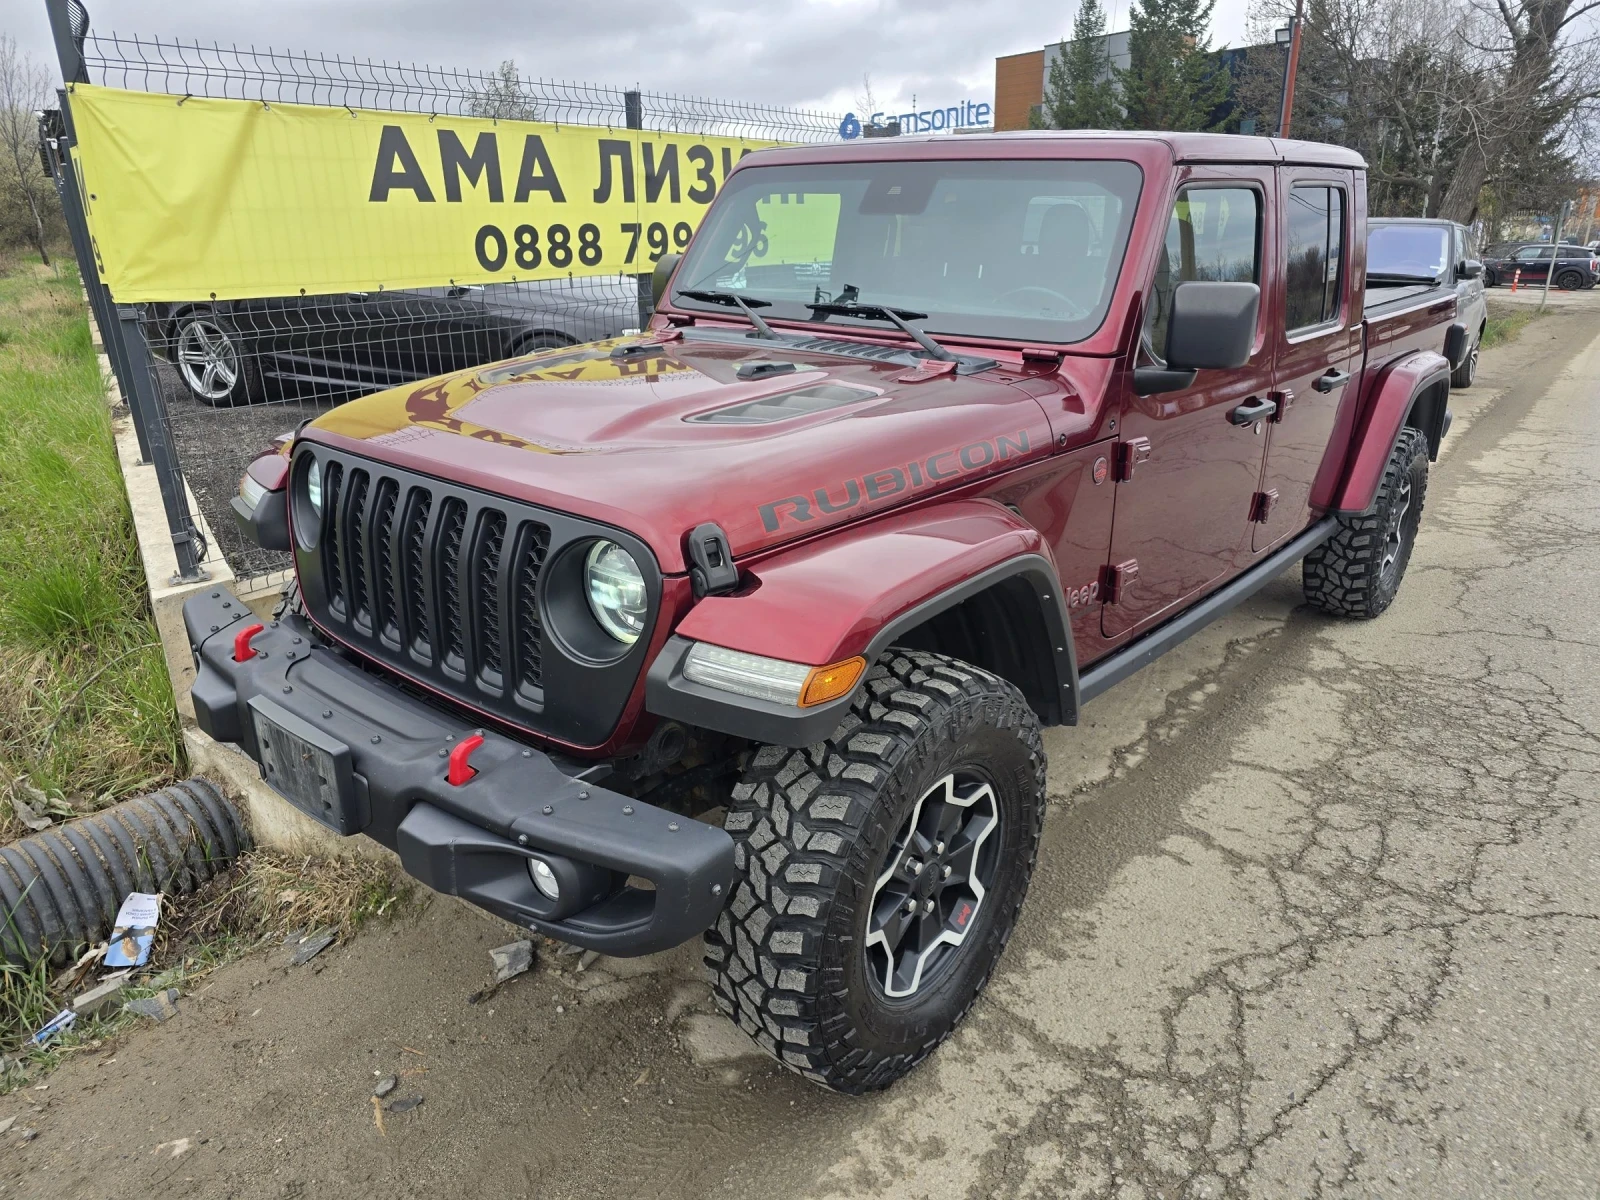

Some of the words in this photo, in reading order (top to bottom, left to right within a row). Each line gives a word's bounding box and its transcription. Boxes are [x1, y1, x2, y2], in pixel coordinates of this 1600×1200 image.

[368, 125, 566, 203] АМА
[474, 223, 603, 272] 0888
[757, 429, 1032, 533] RUBICON
[1064, 581, 1099, 608] Jeep
